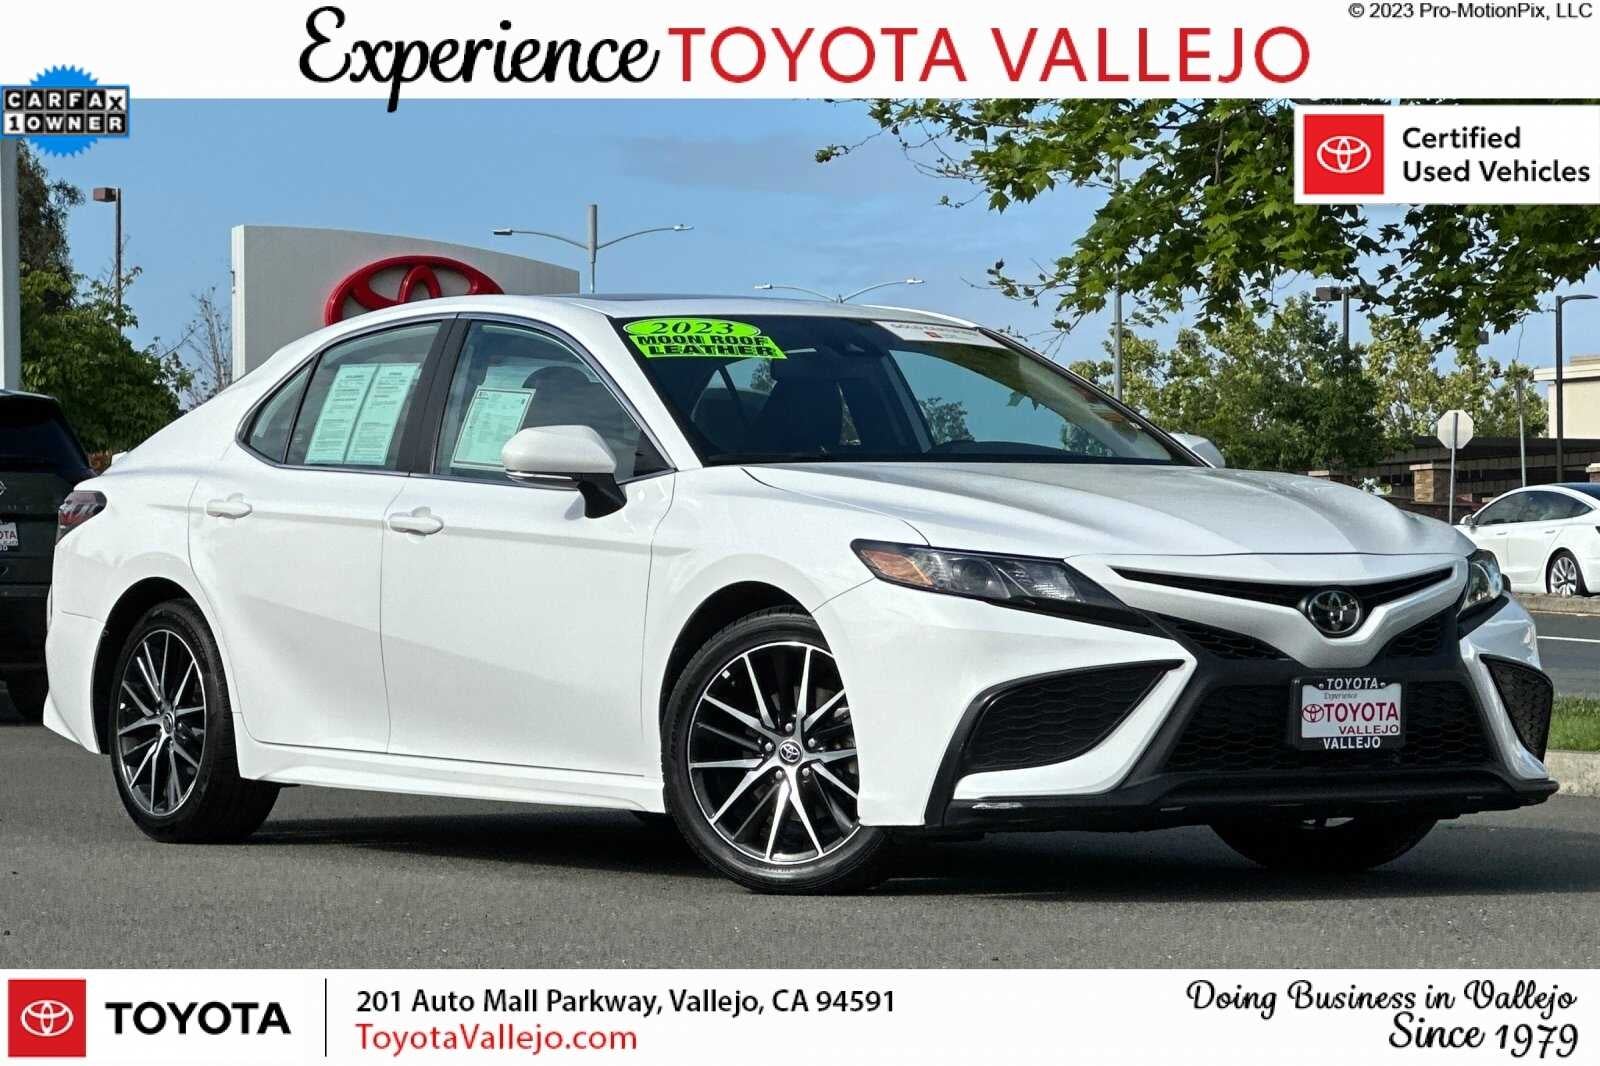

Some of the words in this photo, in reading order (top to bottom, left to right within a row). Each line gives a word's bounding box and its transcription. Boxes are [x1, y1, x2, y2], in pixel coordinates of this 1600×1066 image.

[650, 321, 735, 335] 2023
[637, 336, 703, 345] MOON
[710, 336, 767, 346] ROOF
[648, 345, 774, 356] LEATHER
[1326, 678, 1378, 690] TOYOTA
[1323, 702, 1399, 722] TOYOTA
[1338, 724, 1399, 735] VALLEJO
[1323, 737, 1381, 749] VALLEJO
